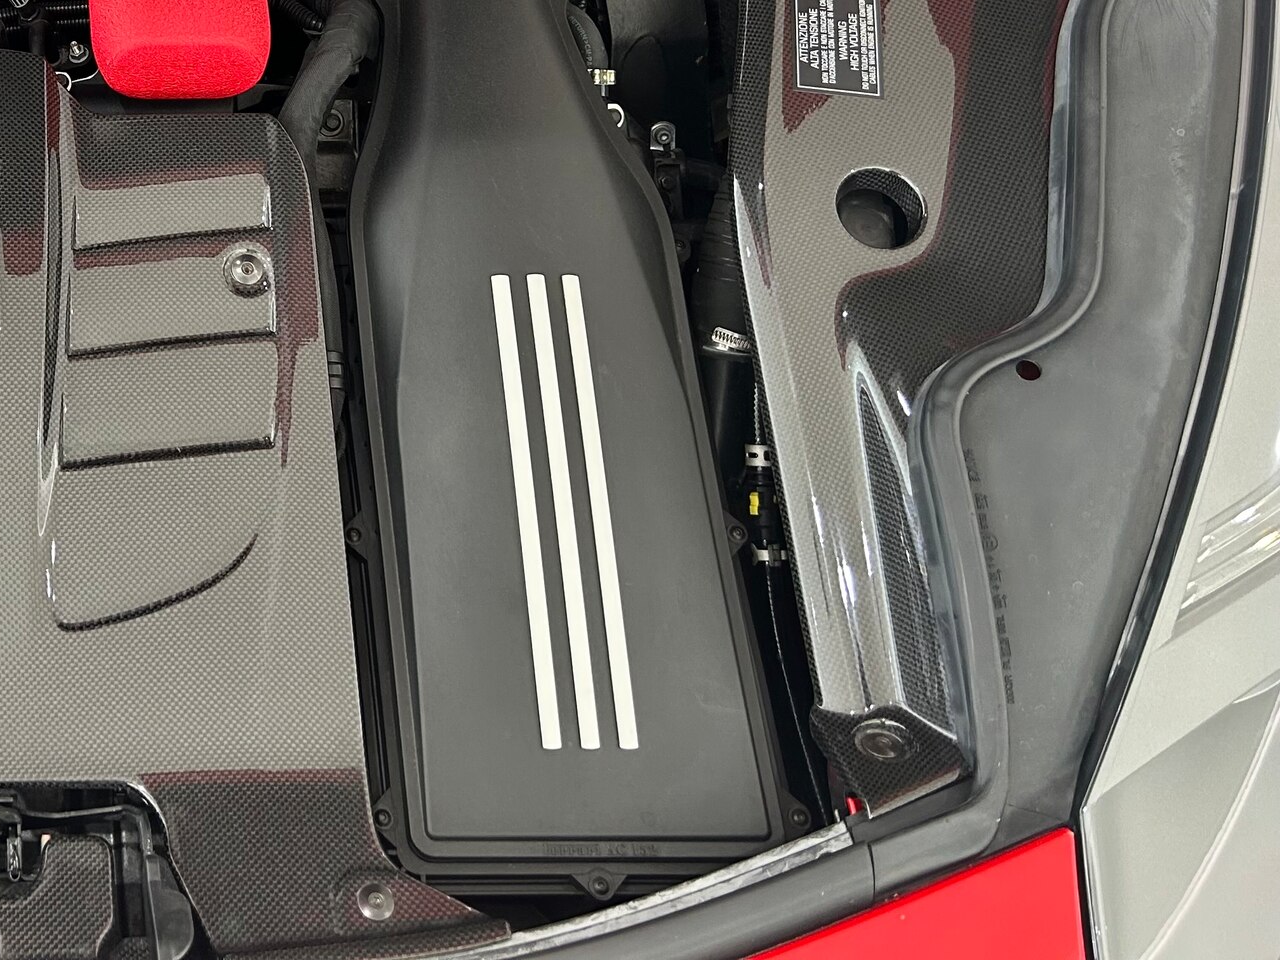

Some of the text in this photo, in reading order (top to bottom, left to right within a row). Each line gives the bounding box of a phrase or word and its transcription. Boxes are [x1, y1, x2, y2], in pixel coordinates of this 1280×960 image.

[819, 10, 827, 33] STACCARE
[827, 18, 835, 38] MOTORE
[799, 12, 809, 63] ATTENZIONE
[809, 8, 820, 69] ALTA TENSIONE
[820, 33, 828, 45] NON
[838, 21, 848, 60] WARNING
[848, 13, 859, 71] HIGH VOLTAGE
[867, 31, 875, 50] ENGINE
[821, 71, 829, 83] NON
[861, 71, 869, 81] NOT
[862, 81, 869, 90] DO
